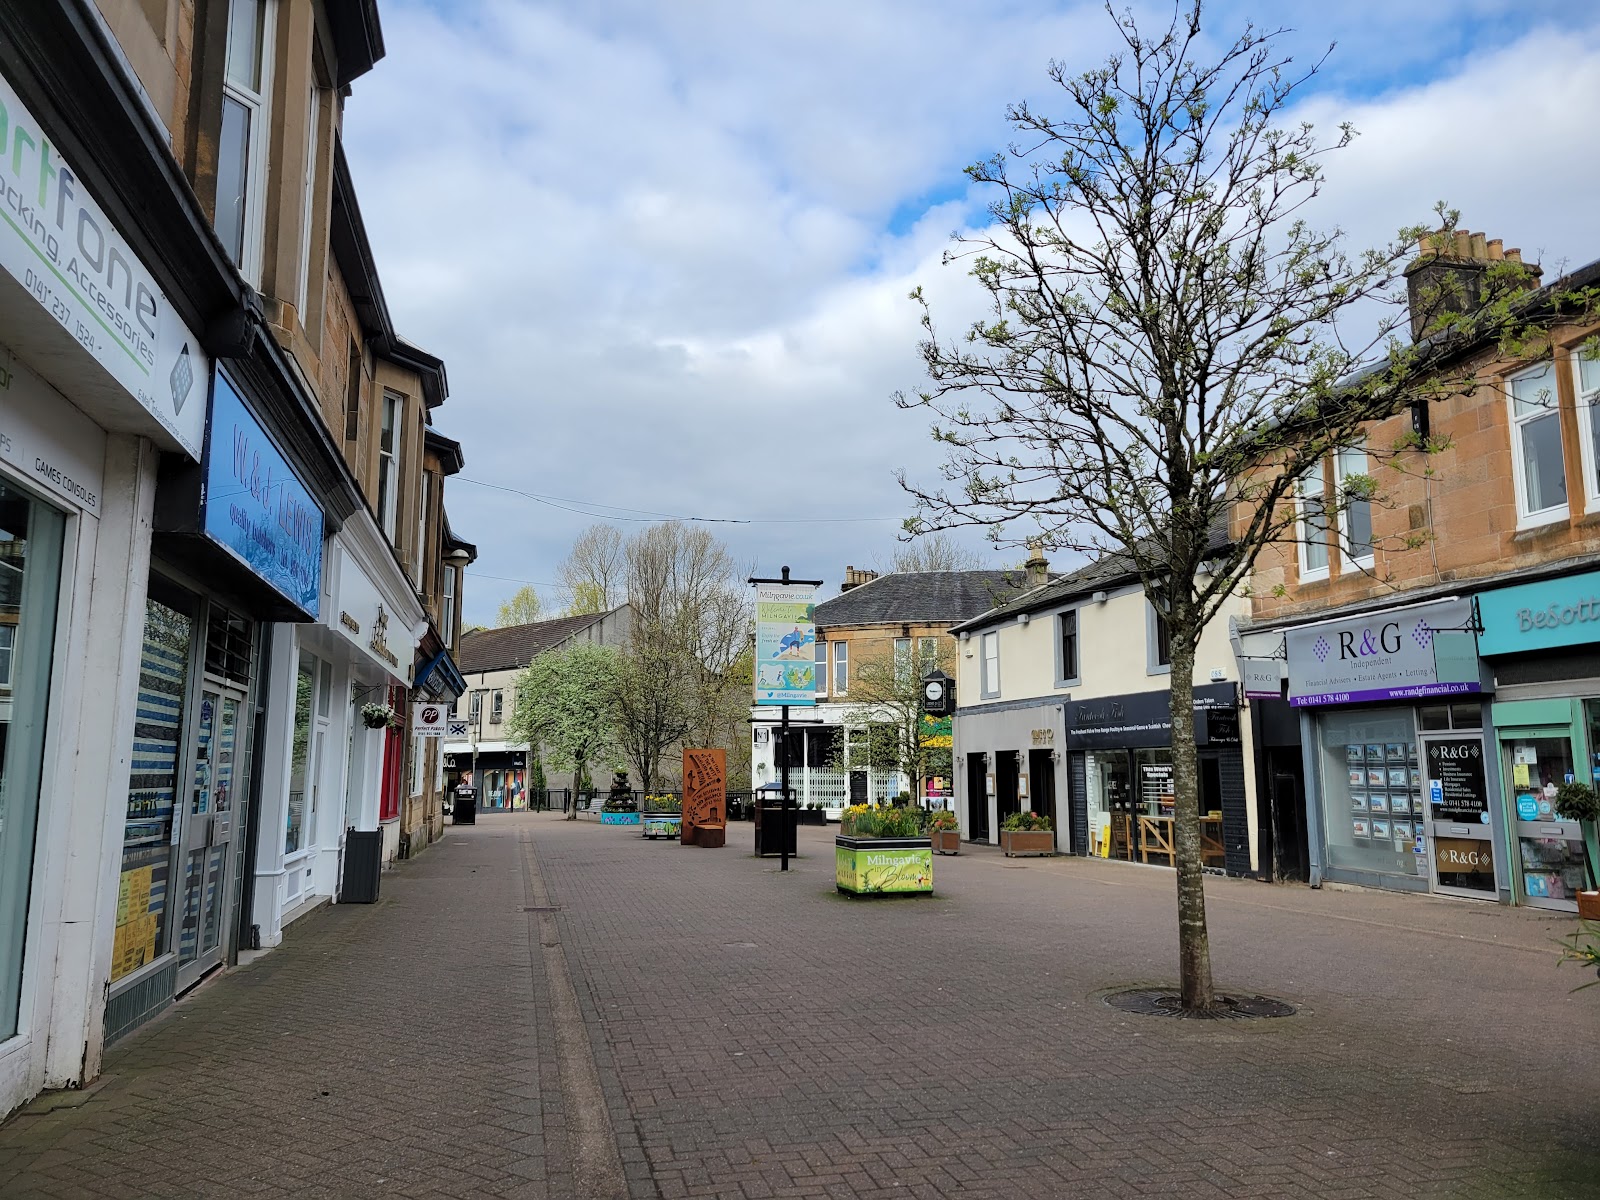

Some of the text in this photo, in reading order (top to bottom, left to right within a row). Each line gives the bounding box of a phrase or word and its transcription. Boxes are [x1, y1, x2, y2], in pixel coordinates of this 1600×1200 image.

[25, 268, 95, 352] 0141 237 1524
[66, 257, 154, 366] Accessories
[35, 457, 96, 507] GAMES CONSOLES
[251, 450, 260, 502] &
[279, 482, 312, 556] LEWIS
[760, 591, 813, 601] Milngavie.co.uk
[1337, 621, 1402, 660] R&G
[1351, 657, 1391, 669] Independent
[1254, 673, 1272, 682] R&G
[1305, 677, 1328, 687] Financial
[1358, 673, 1376, 681] Estate
[1377, 670, 1398, 681] Agents
[1405, 667, 1428, 677] Letting
[777, 691, 807, 699] @Milngavie
[1389, 682, 1469, 698] www.randgfinancial.co.uk
[1296, 693, 1350, 705] Tel: 0141 578 4100
[1440, 745, 1469, 759] R&G
[867, 853, 921, 867] Milngavie
[1449, 849, 1479, 865] R&G
